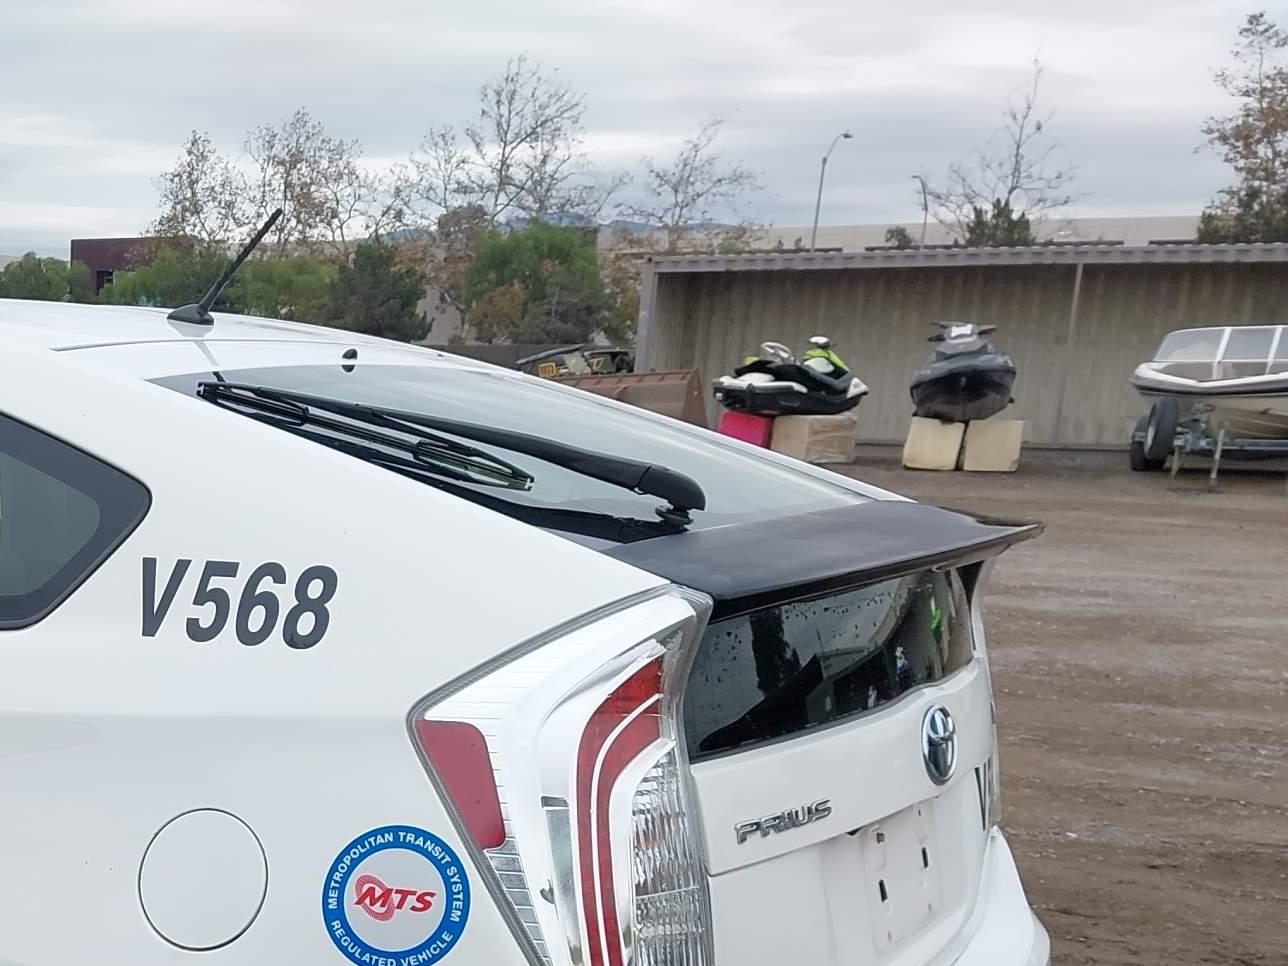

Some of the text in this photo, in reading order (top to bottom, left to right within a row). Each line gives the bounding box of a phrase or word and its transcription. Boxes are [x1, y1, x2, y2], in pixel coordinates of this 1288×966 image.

[141, 557, 338, 650] V568
[734, 799, 832, 845] PRIUS
[328, 831, 464, 922] METROPOLITAN TRANSIT SYSTEM
[354, 886, 436, 913] MTS
